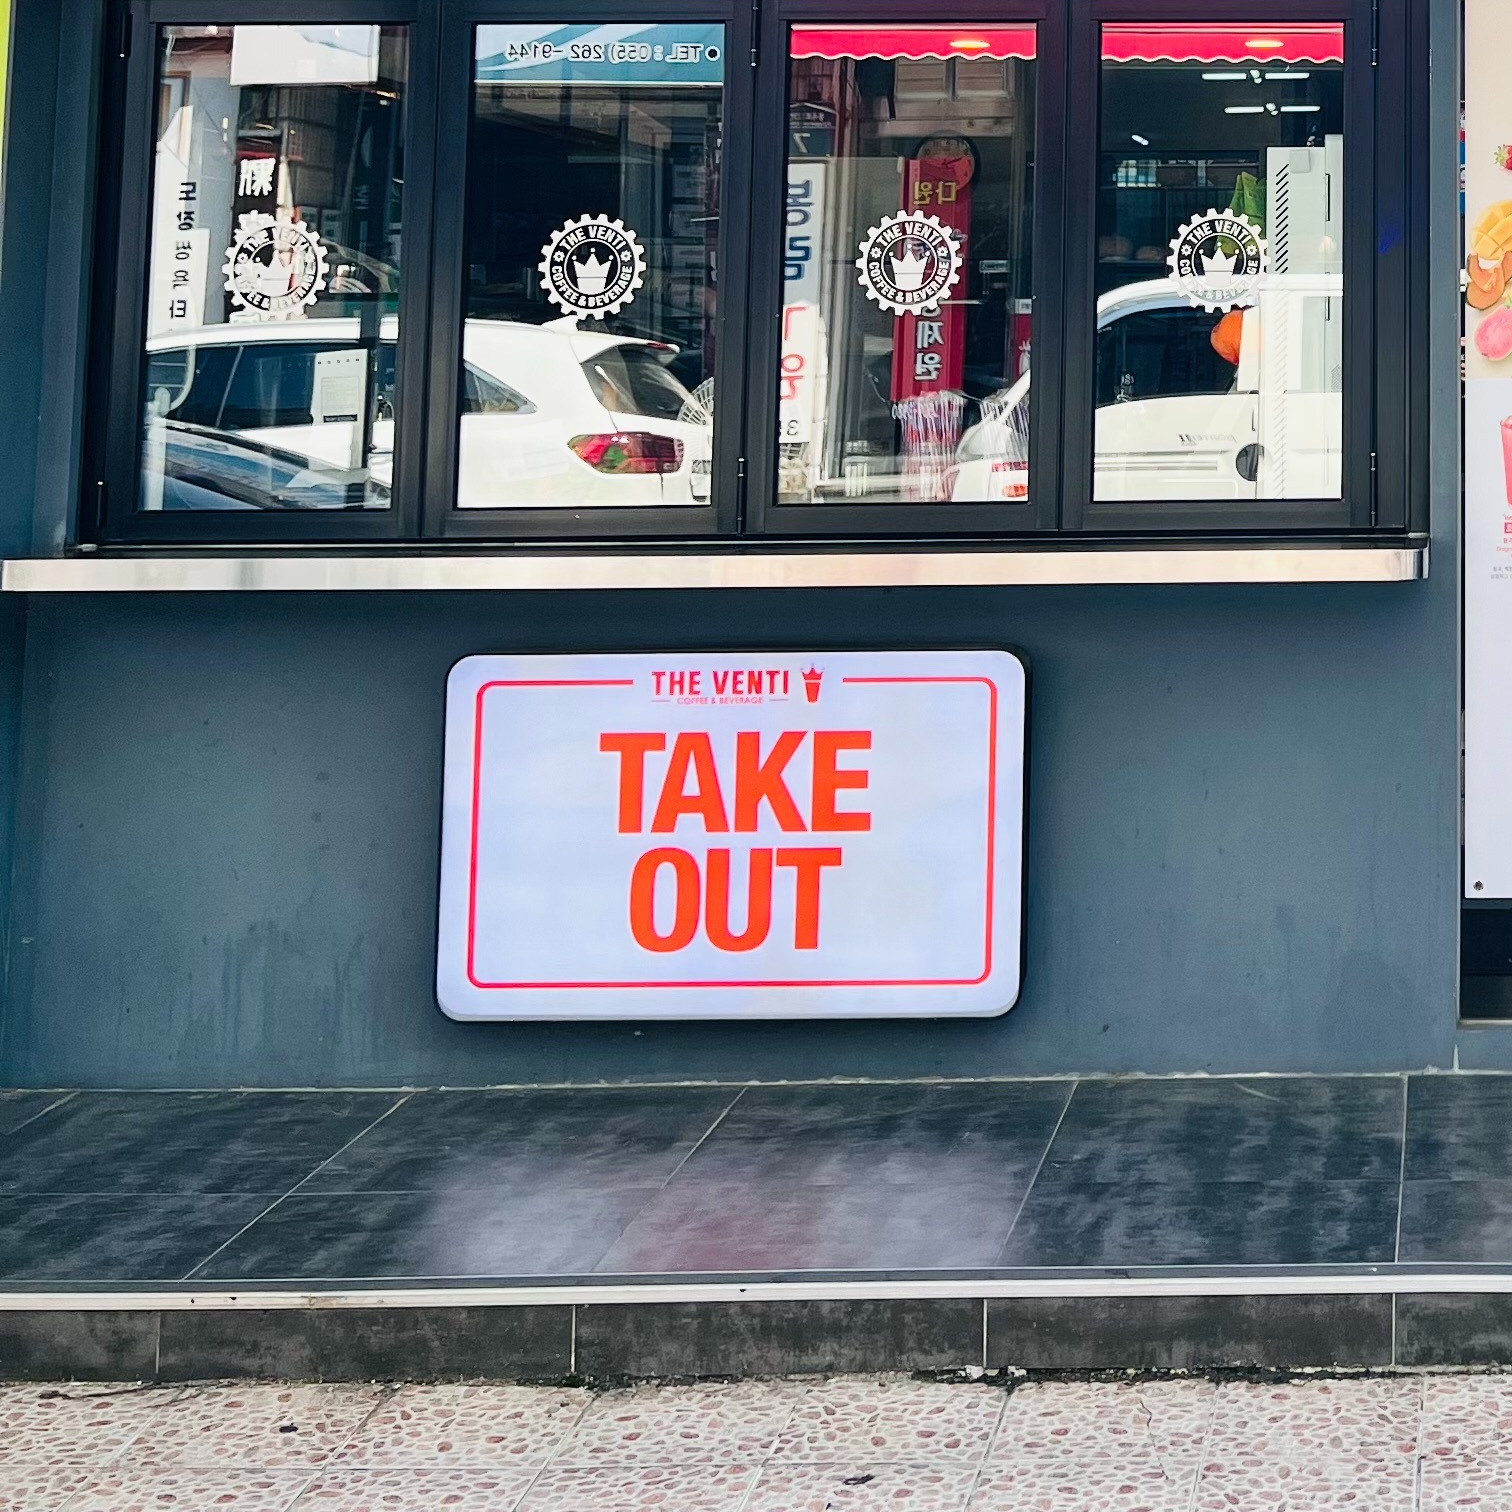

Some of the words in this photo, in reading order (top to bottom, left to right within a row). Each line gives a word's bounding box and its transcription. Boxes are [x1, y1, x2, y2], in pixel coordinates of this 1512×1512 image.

[559, 227, 586, 251] THE
[588, 225, 627, 251] VENTI
[876, 223, 903, 248] THE
[904, 221, 943, 248] VENTI
[1186, 222, 1213, 244] THE
[1214, 219, 1253, 245] VENTI
[551, 265, 580, 304] COFFEE
[587, 265, 633, 308] BEVERAGE
[868, 261, 897, 299] COFFEE
[651, 670, 701, 696] THE
[712, 669, 789, 695] VENTI
[676, 696, 709, 705] COFFEE
[719, 695, 764, 705] BEVERAGE
[599, 730, 872, 834] TAKE
[629, 847, 842, 953] OUT
